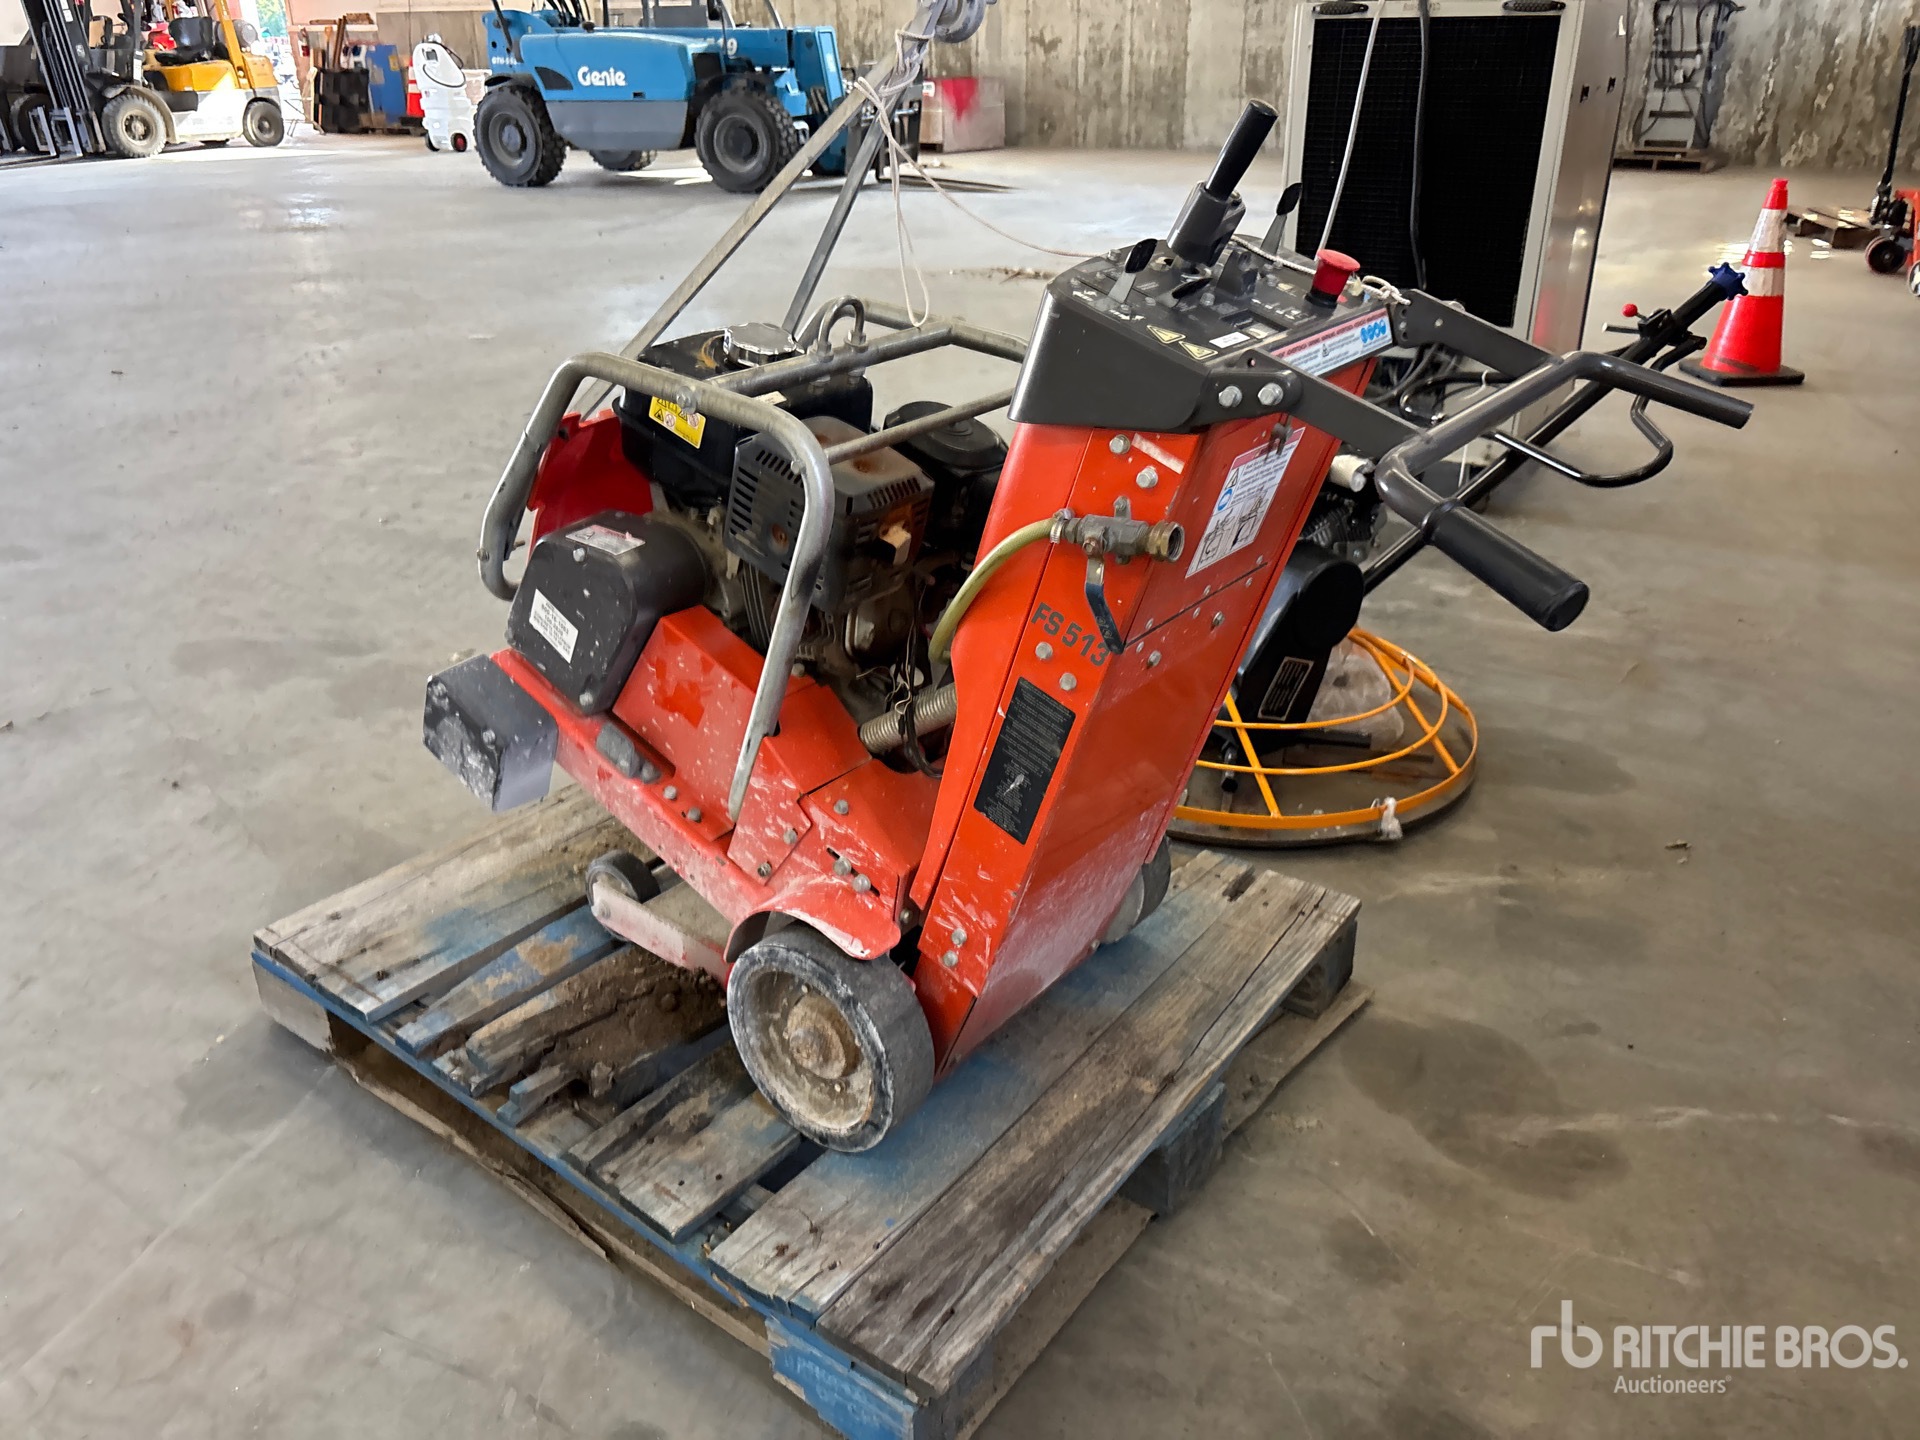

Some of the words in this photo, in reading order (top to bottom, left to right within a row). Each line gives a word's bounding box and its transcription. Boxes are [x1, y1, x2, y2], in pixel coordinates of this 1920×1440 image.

[577, 65, 626, 86] Genie
[1031, 602, 1065, 636] FS
[1061, 621, 1111, 667] 513
